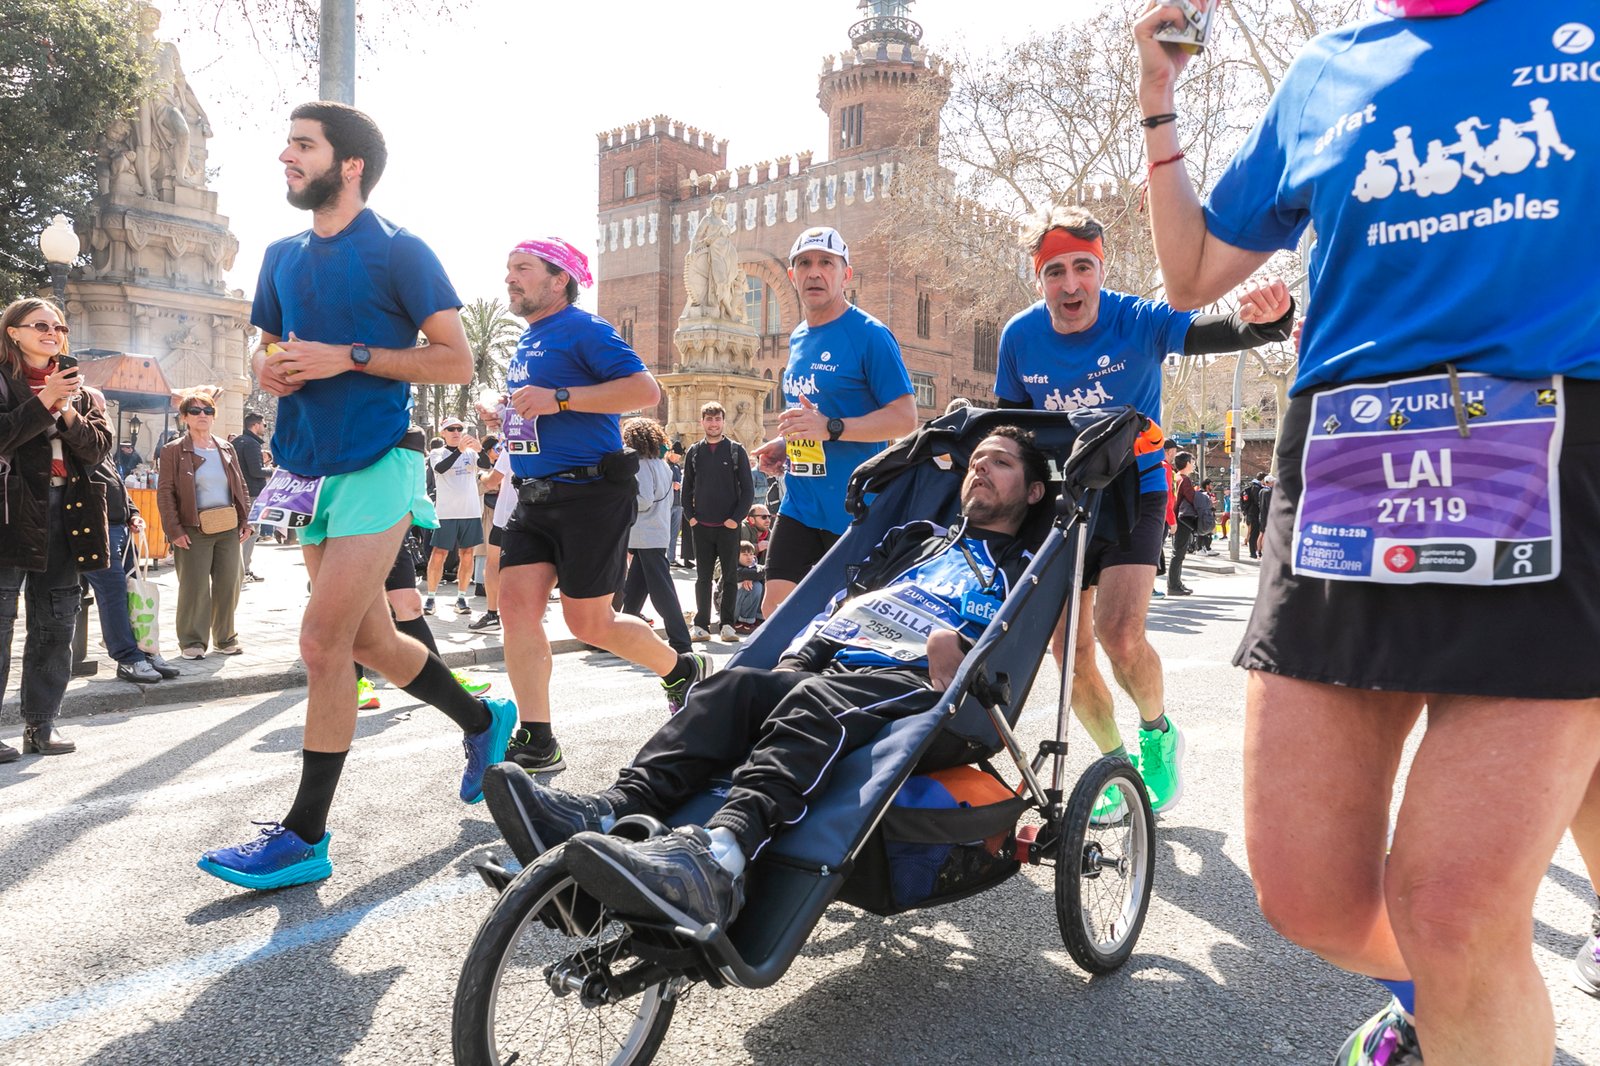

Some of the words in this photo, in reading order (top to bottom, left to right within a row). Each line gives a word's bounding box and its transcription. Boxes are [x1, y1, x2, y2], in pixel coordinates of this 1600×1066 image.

[1313, 102, 1377, 156] aefat
[1367, 193, 1560, 247] #Imparables
[810, 363, 836, 373] ZURICH
[1088, 363, 1125, 380] ZURICH
[1382, 448, 1452, 489] LAI
[1377, 497, 1467, 523] 27119
[1311, 524, 1337, 536] Start
[1339, 527, 1368, 538] 9:25h
[1300, 555, 1362, 571] BARCELONA
[1302, 546, 1345, 560] MARATÓ
[1419, 556, 1466, 565] Barcelona
[904, 588, 941, 612] ZURICH
[865, 620, 903, 643] 25252
